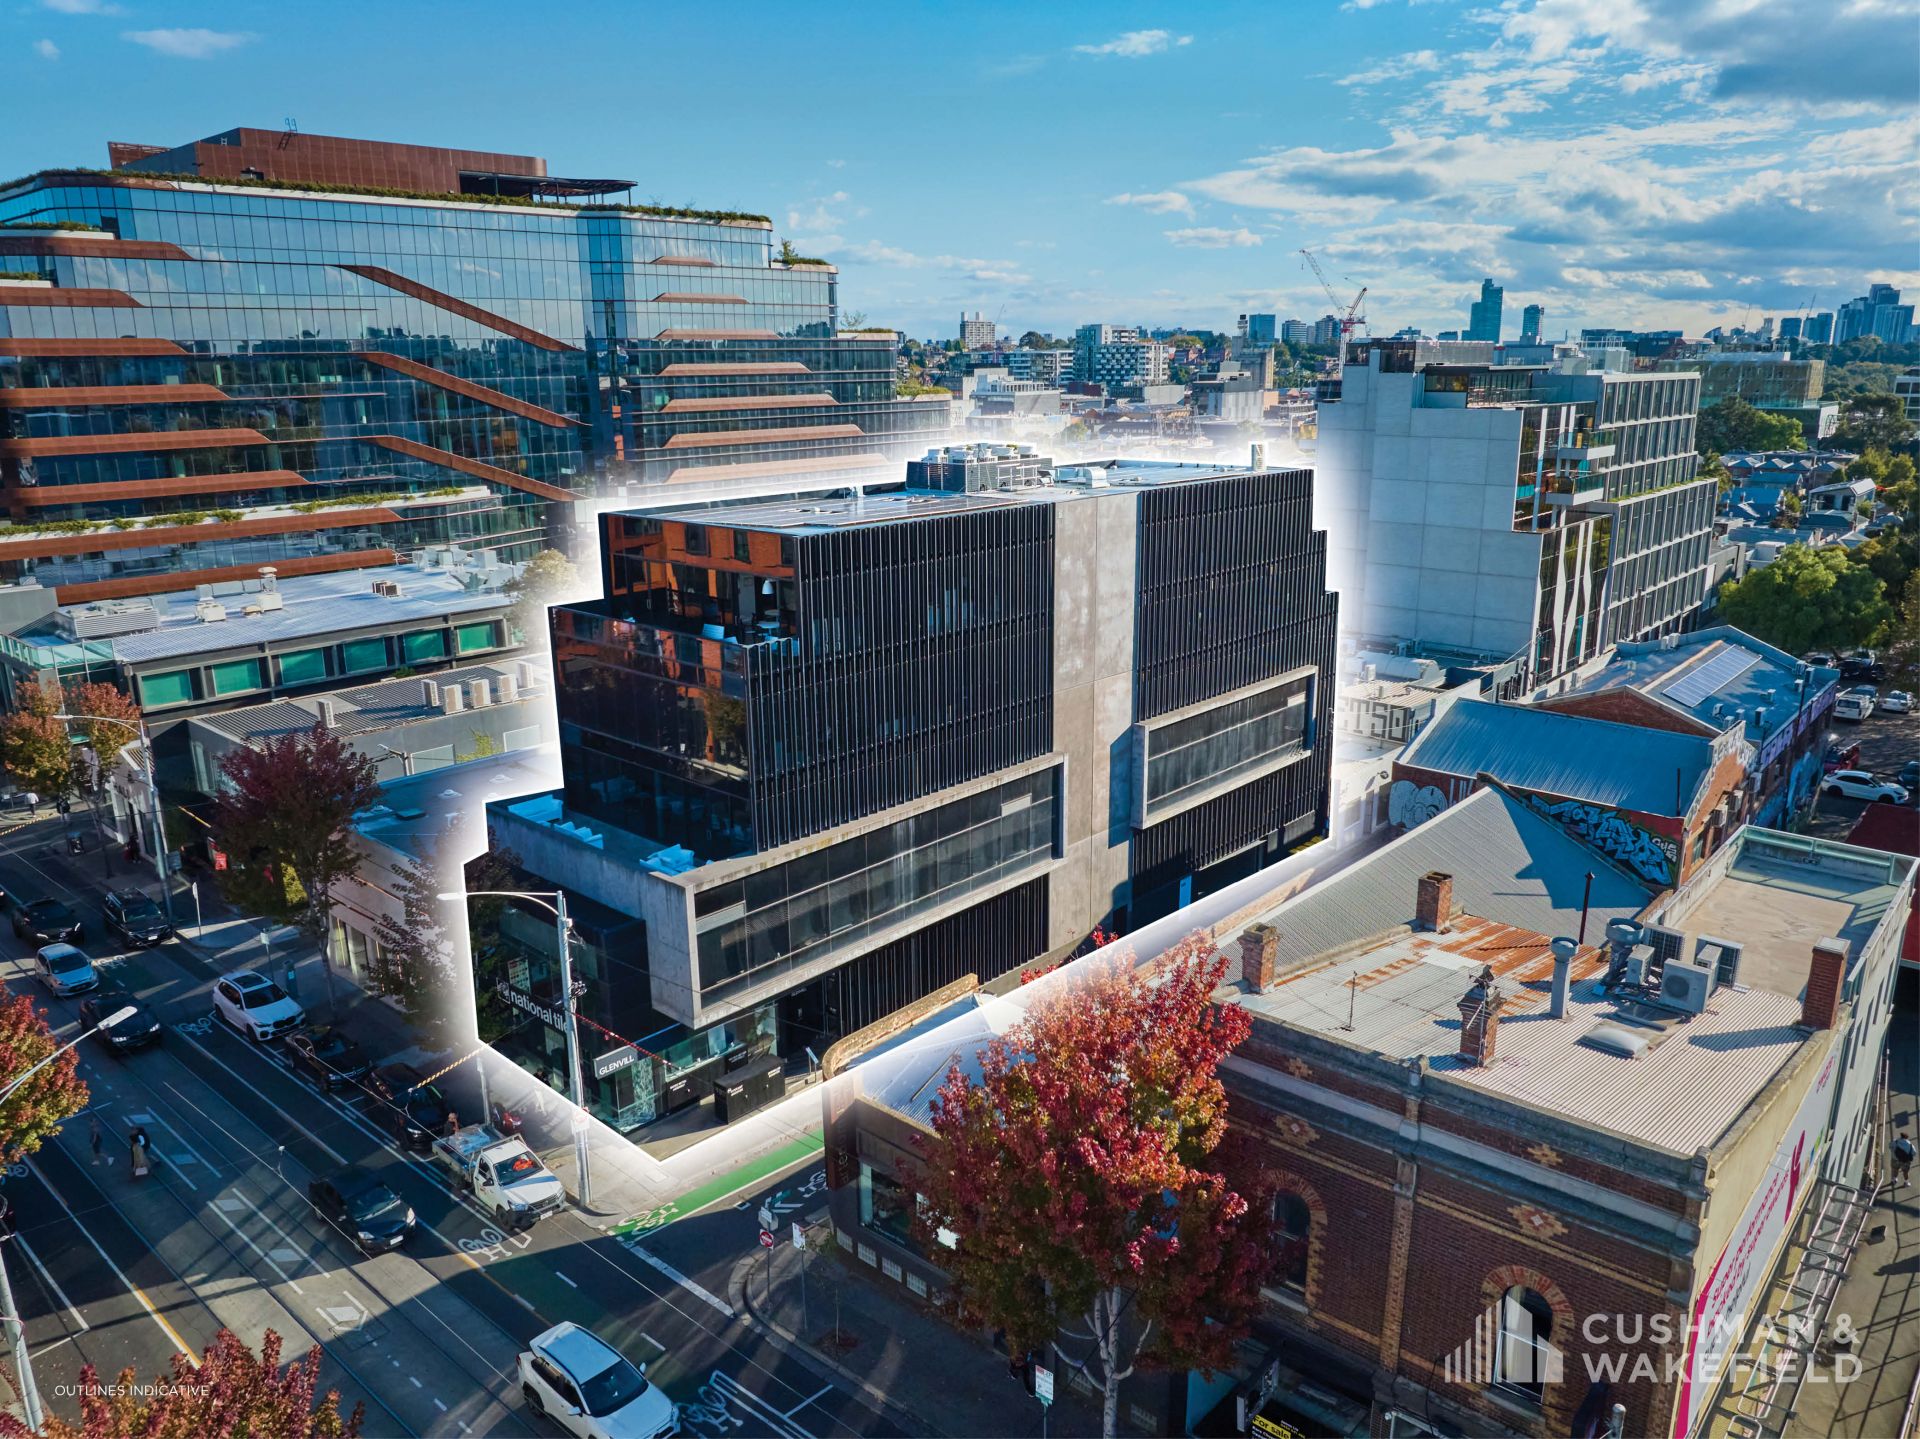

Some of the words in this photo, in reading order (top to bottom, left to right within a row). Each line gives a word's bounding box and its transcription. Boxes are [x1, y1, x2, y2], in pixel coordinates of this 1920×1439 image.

[510, 991, 552, 1025] national
[599, 1055, 635, 1076] GLENVILL
[1253, 1417, 1268, 1428] For
[1271, 1426, 1289, 1439] sale
